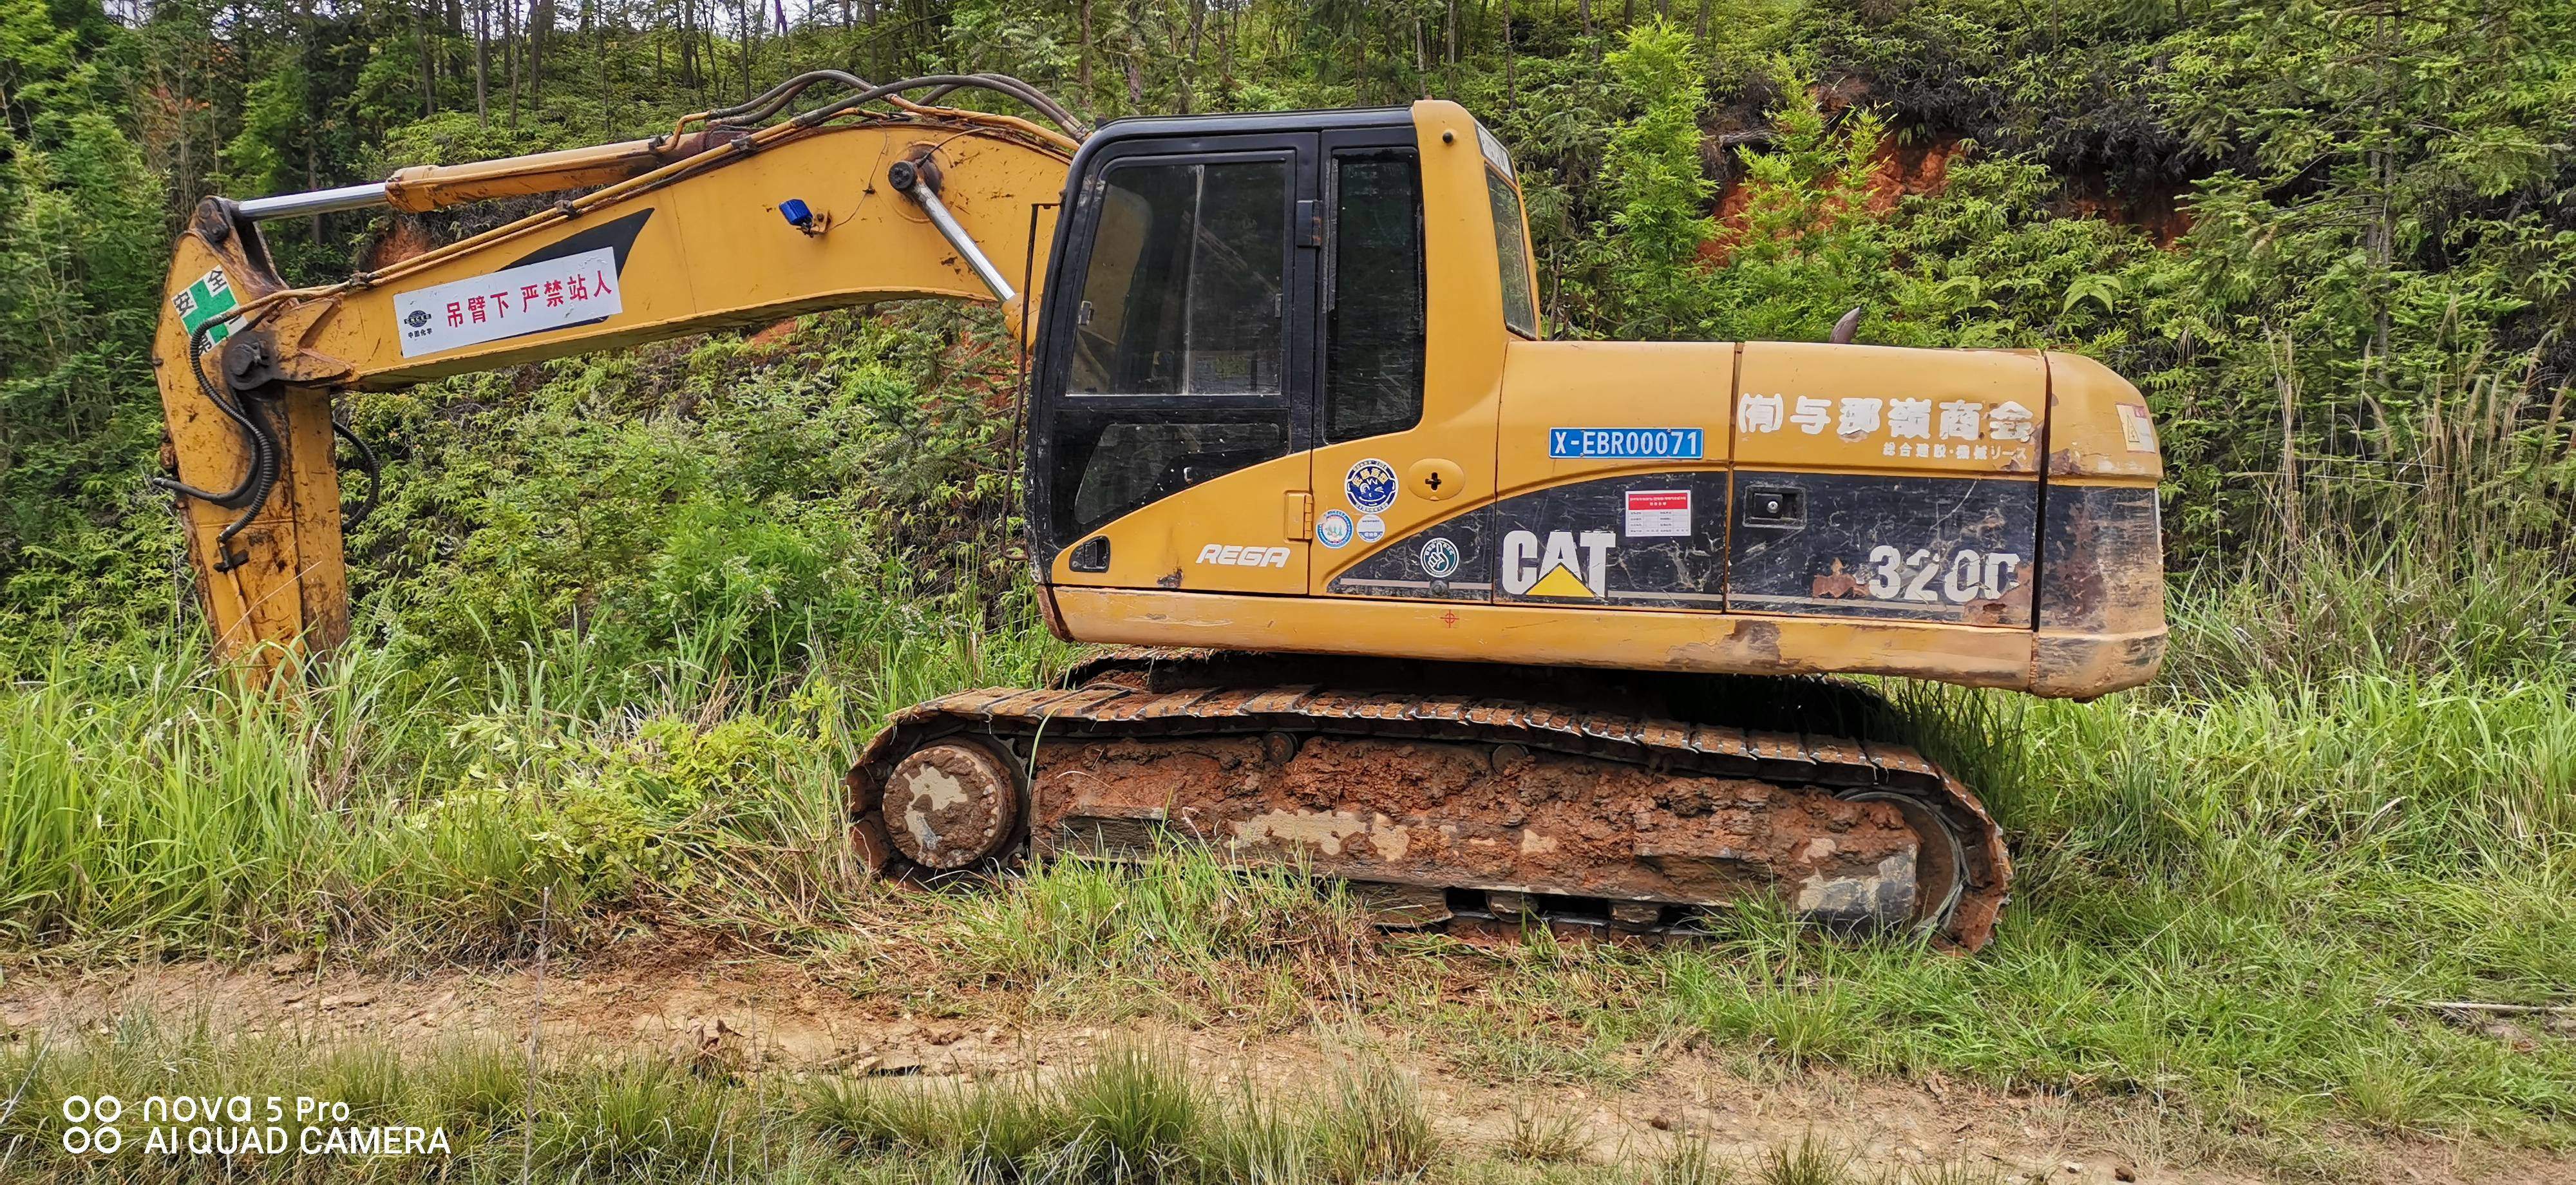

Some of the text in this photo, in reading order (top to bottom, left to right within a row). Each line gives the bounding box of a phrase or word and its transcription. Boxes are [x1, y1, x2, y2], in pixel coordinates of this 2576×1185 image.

[446, 270, 612, 328] 吊臂下 严禁站人
[1554, 431, 1698, 455] X-EBR00071
[1195, 544, 1291, 568] REGA
[1502, 529, 1616, 598] CAT
